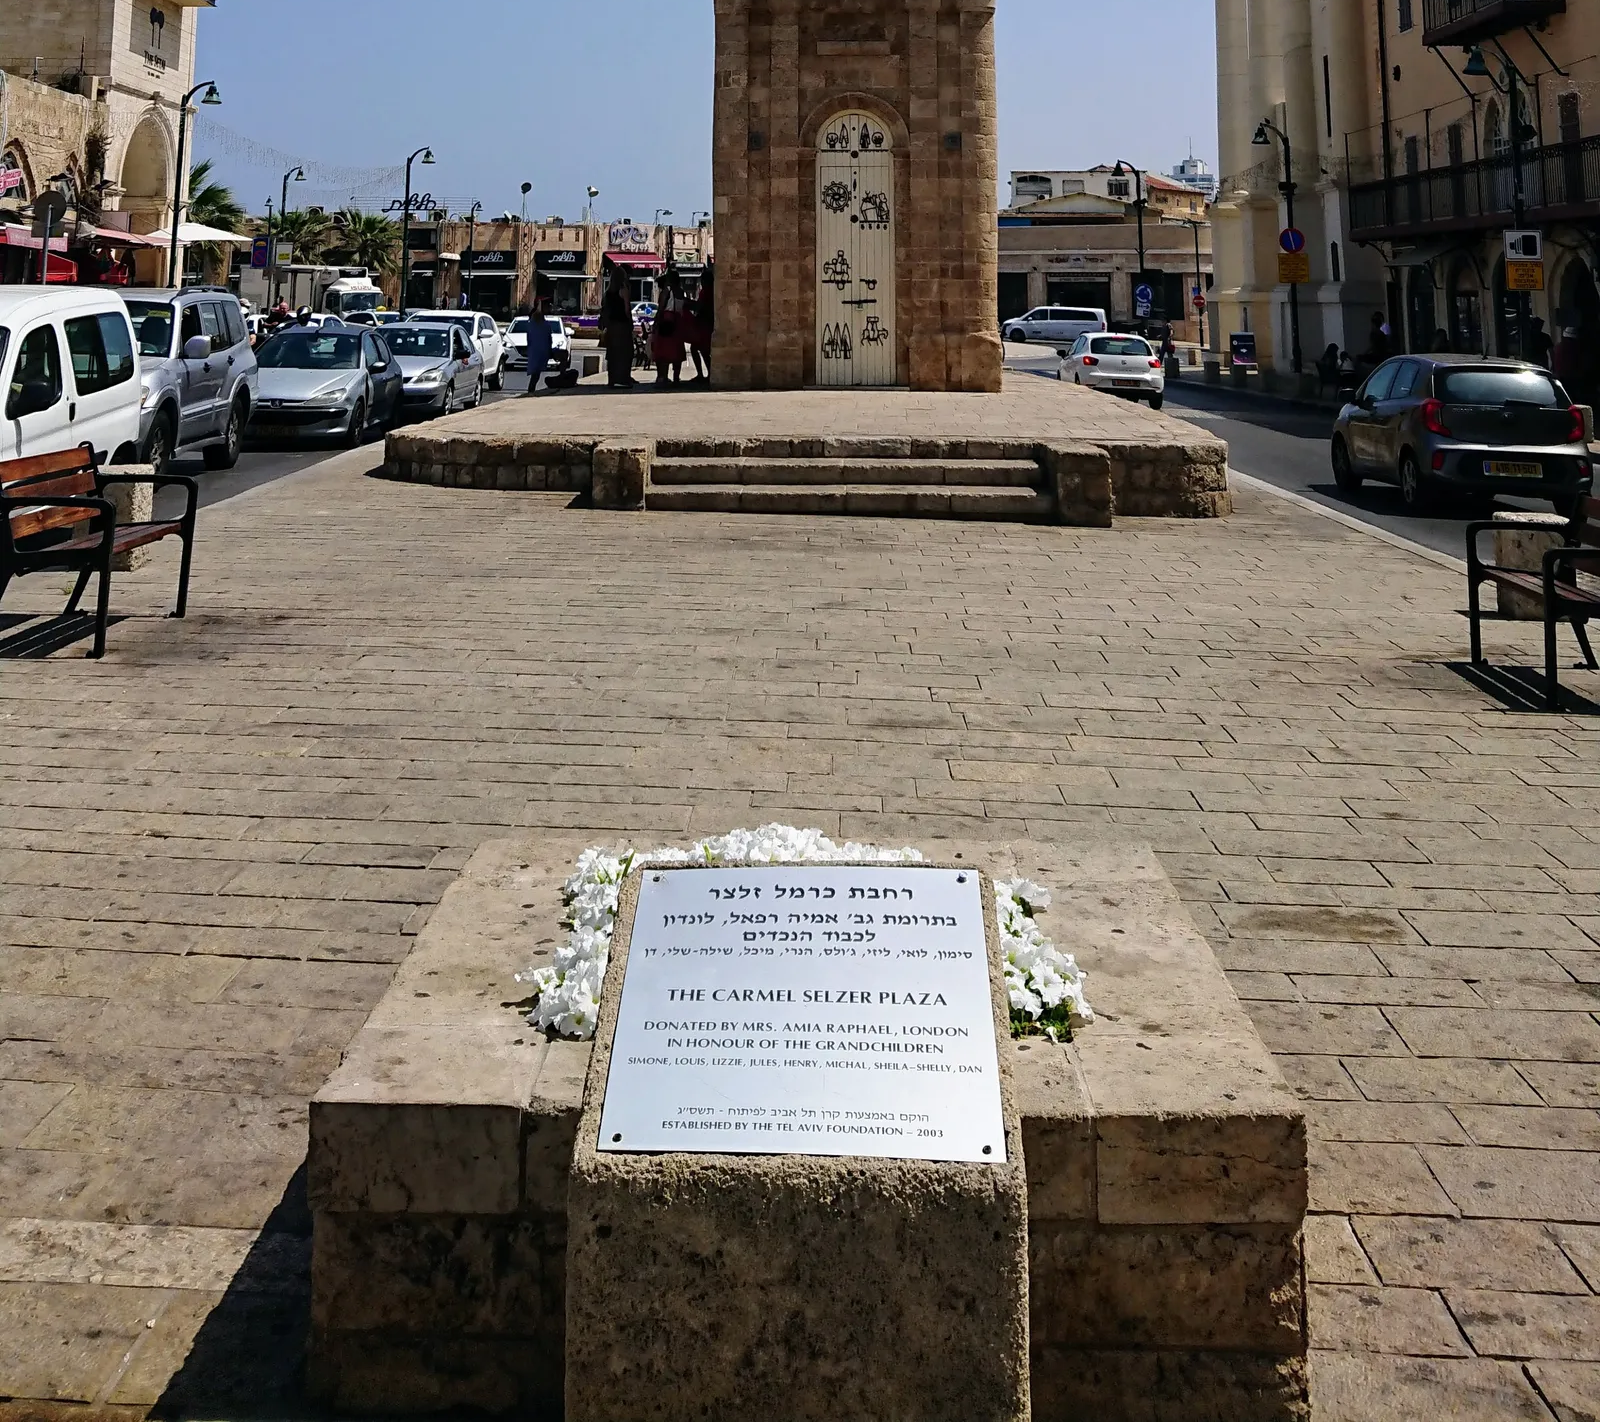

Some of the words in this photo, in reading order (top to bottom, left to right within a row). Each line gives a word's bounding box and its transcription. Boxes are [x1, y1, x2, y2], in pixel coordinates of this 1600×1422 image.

[709, 885, 761, 900] זלצר
[775, 884, 835, 899] כרמל
[848, 887, 913, 900] רחבת
[663, 912, 714, 928] לונדון
[722, 911, 778, 926] רפאל,
[788, 913, 838, 924] אמיה
[882, 914, 957, 926] בתרומת
[743, 931, 812, 941] הנכדים
[822, 929, 875, 942] לכבוד
[645, 948, 657, 958] דן
[662, 946, 733, 957] שילה-שלי,
[738, 946, 774, 957] מיכל,
[780, 948, 812, 956] הנרי,
[862, 947, 890, 958] ליזי,
[896, 949, 927, 959] לואי,
[933, 951, 972, 960] סימון,
[668, 989, 706, 1001] THE
[712, 989, 796, 1002] CARMEL
[803, 990, 872, 1004] SELZER
[879, 992, 947, 1006] PLAZA
[644, 1021, 716, 1031] DONATED
[721, 1022, 738, 1031] BY
[742, 1022, 776, 1031] MRS.
[782, 1023, 821, 1032] AMIA
[827, 1024, 897, 1036] RAPHAEL,
[903, 1026, 968, 1036] LONDON
[668, 1038, 682, 1047] IN
[686, 1038, 754, 1048] HONOUR
[759, 1039, 779, 1049] OF
[784, 1040, 811, 1049] THE
[815, 1041, 943, 1053] GRANDCHILDREN
[628, 1057, 671, 1066] SIMONE,
[675, 1058, 708, 1066] LOUIS,
[712, 1058, 746, 1067] LIZZIE,
[750, 1059, 780, 1067] JULES,
[784, 1060, 822, 1068] HENRY,
[826, 1061, 870, 1070] MICHAL,
[959, 1065, 982, 1073] DAN
[728, 1107, 766, 1116] לפיתוח
[771, 1109, 796, 1117] אביב
[801, 1108, 816, 1117] תל
[821, 1111, 840, 1120] קרן
[845, 1111, 894, 1120] באמצעות
[900, 1114, 928, 1123] הוקם
[662, 1121, 731, 1129] ESTABLISHED
[735, 1122, 748, 1130] BY
[752, 1123, 772, 1131] THE
[776, 1123, 793, 1131] TEL
[797, 1124, 823, 1132] AVIV
[827, 1125, 903, 1135] FOUNDATION
[917, 1129, 943, 1137] 2003
